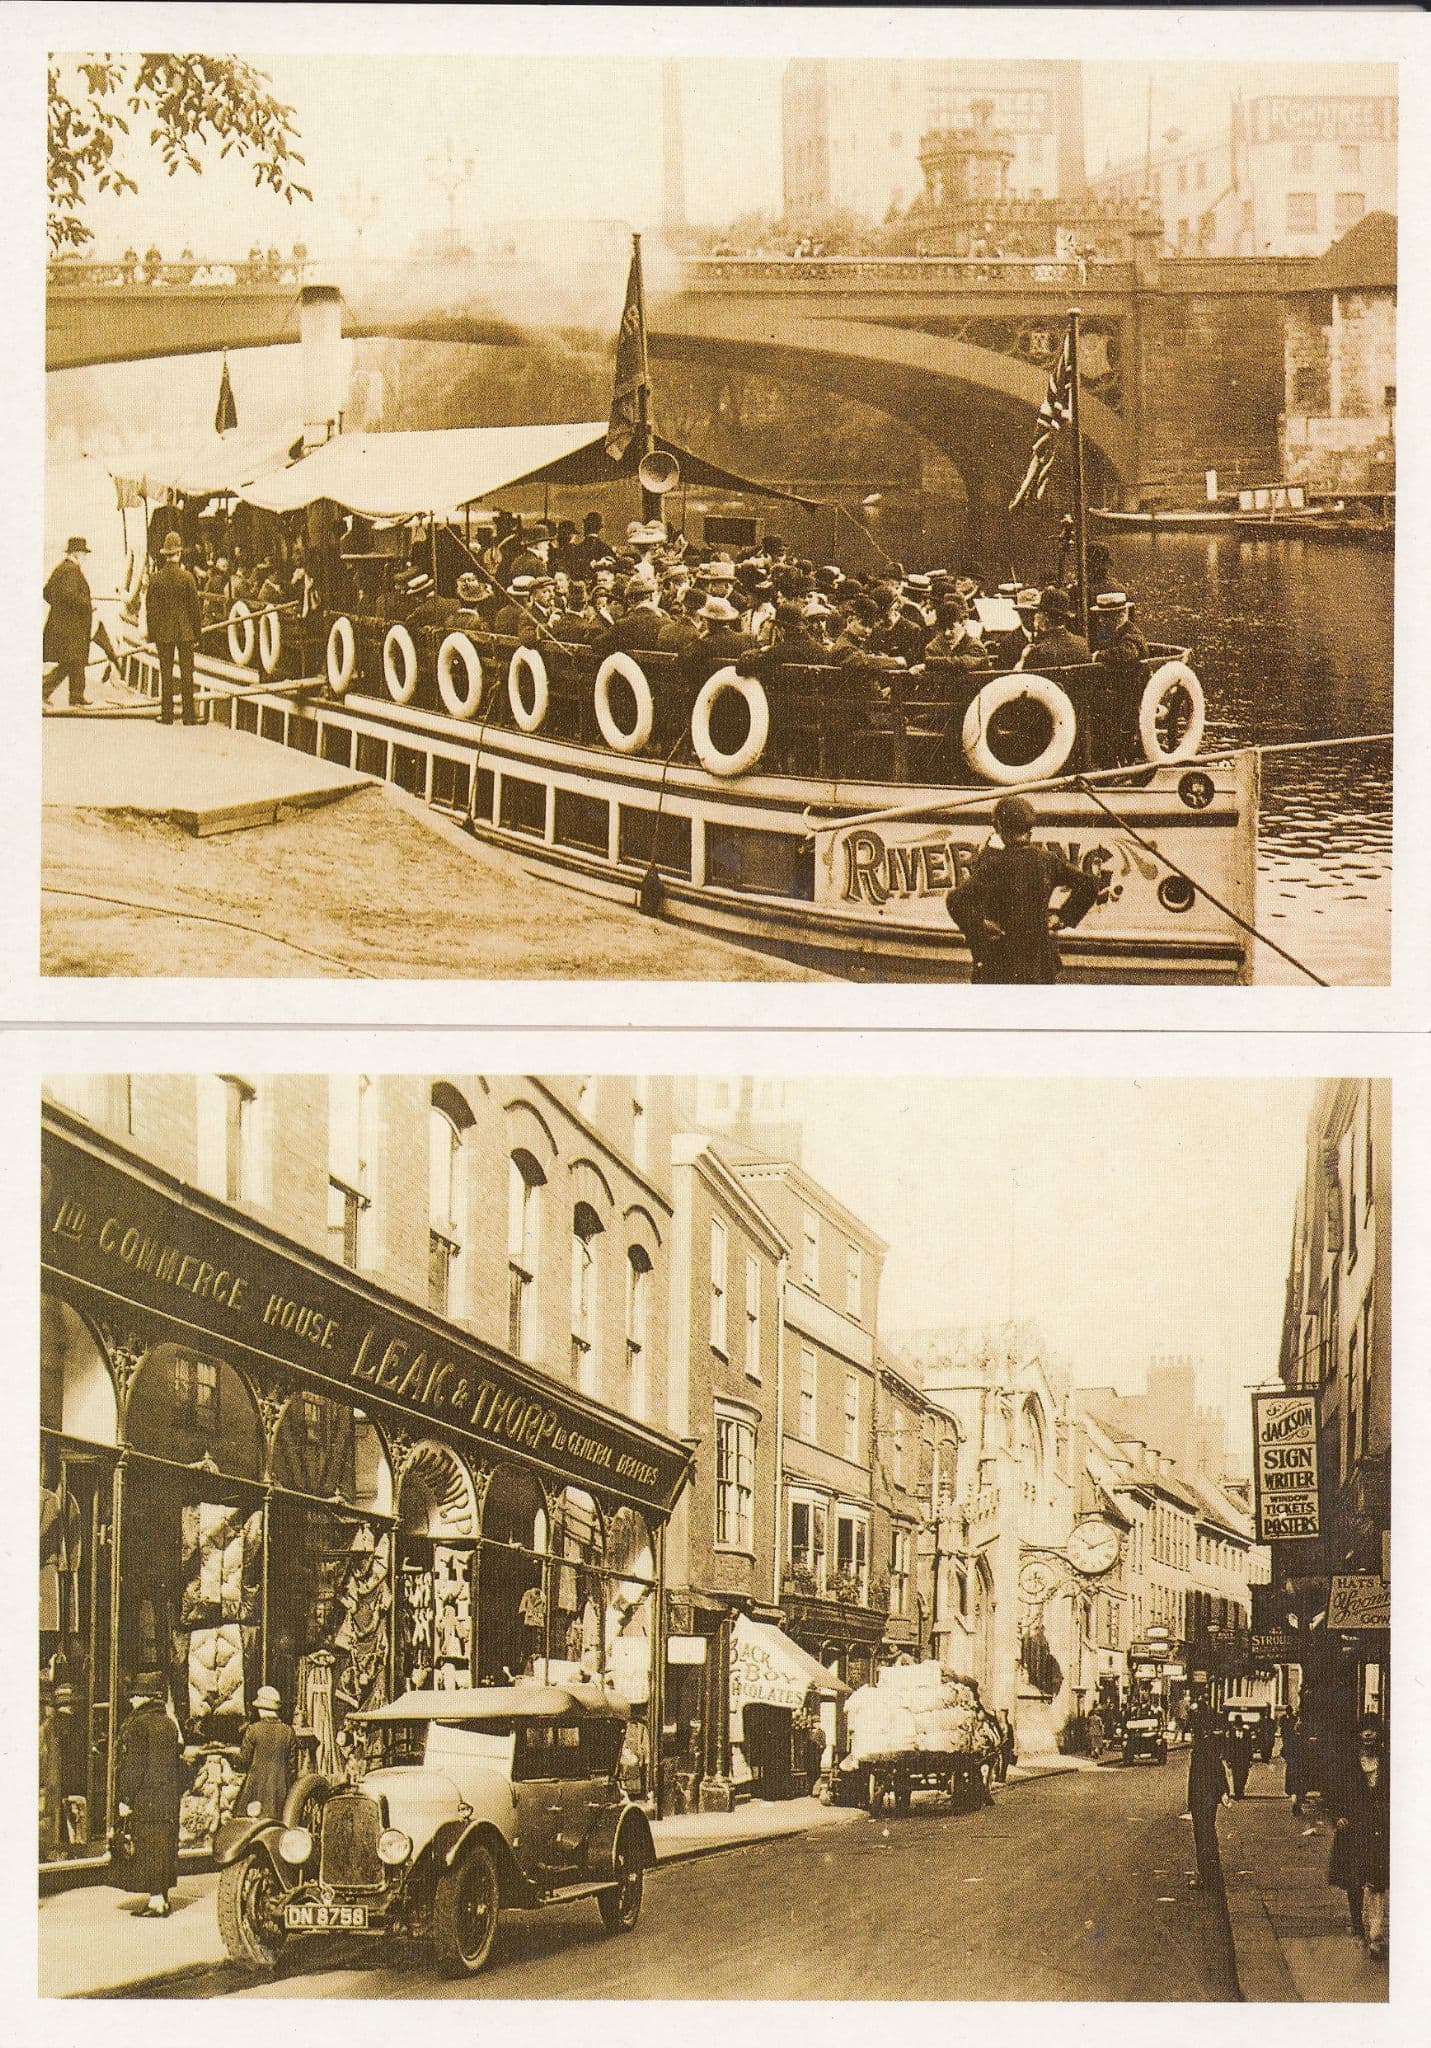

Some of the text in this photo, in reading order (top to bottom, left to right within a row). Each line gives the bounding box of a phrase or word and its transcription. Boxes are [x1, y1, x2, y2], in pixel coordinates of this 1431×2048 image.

[839, 829, 975, 905] RIVER
[99, 1216, 249, 1311] COMMERCE
[262, 1293, 340, 1350] HOUSE
[351, 1327, 455, 1407] LEAK
[451, 1378, 469, 1410] &
[471, 1378, 557, 1450] THORP
[567, 1431, 613, 1469] GENERAL
[1261, 1407, 1313, 1442] JACKSON
[1264, 1447, 1313, 1470] SIGN
[1264, 1470, 1315, 1491] WRITER
[1264, 1502, 1317, 1515] TICKETS
[1269, 1493, 1309, 1503] WINDOW
[1263, 1515, 1318, 1536] POSTERS
[1337, 1578, 1375, 1589] HATS
[288, 1907, 314, 1926] DN
